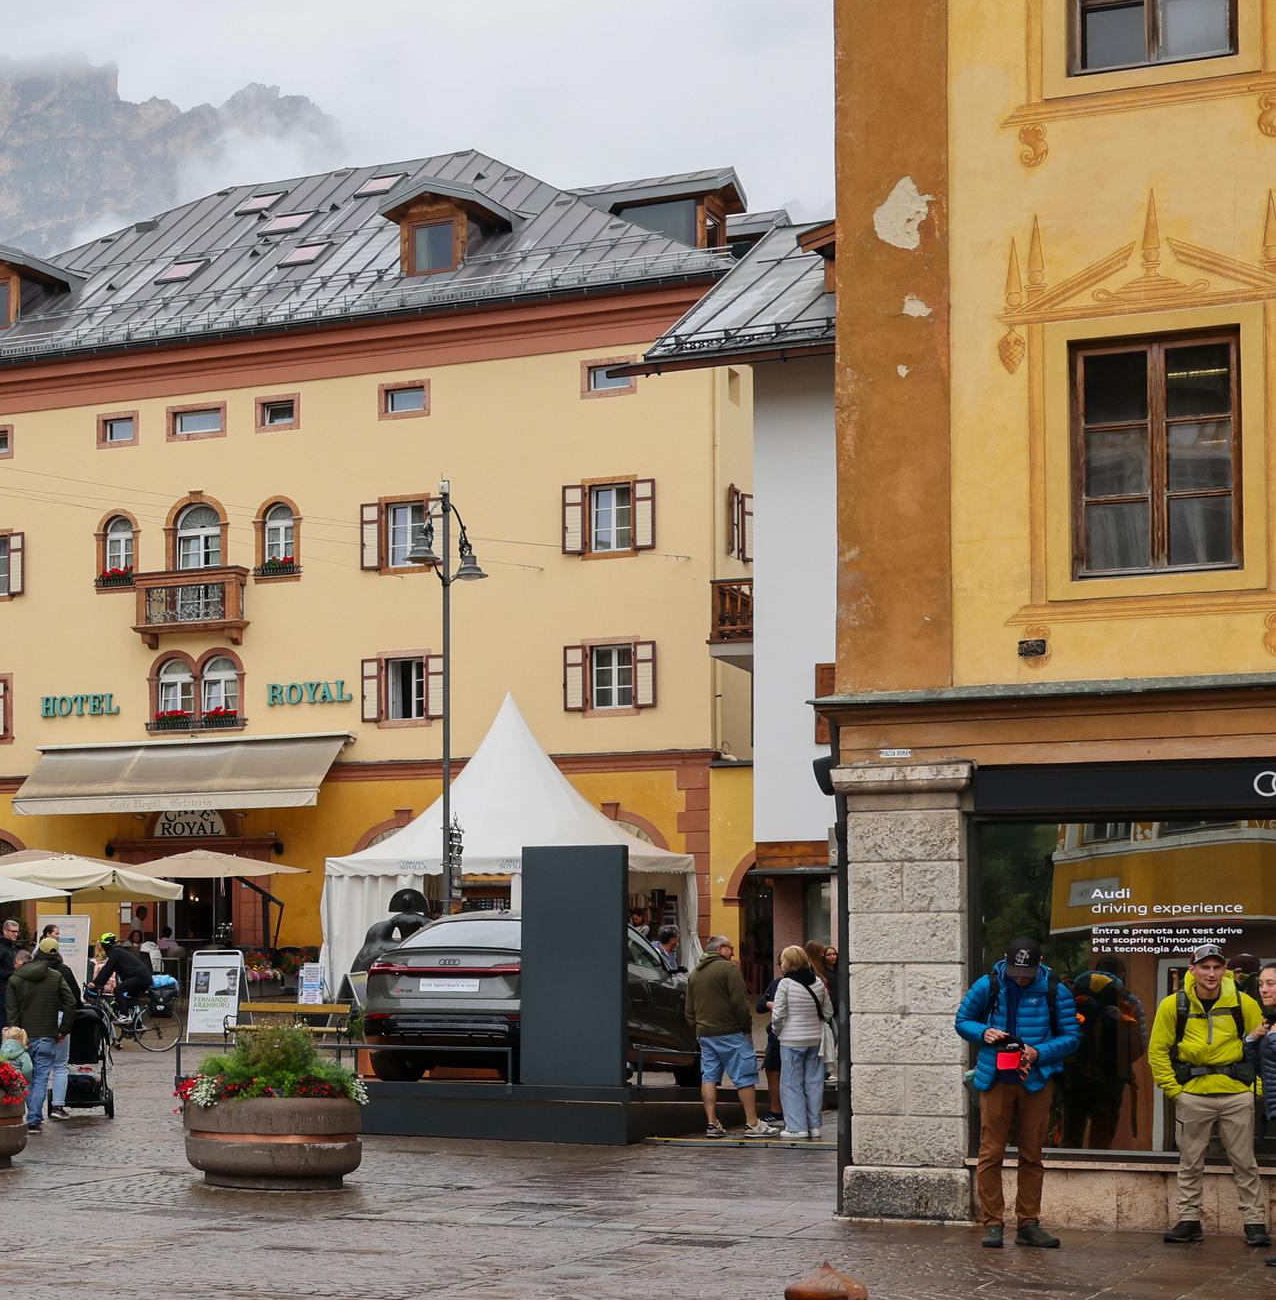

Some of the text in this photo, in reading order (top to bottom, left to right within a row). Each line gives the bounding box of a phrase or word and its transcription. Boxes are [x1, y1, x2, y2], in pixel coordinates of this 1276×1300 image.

[40, 679, 353, 717] HOTEL ROYAL
[160, 821, 221, 836] ROYAL
[1091, 888, 1131, 899] Audi
[1091, 902, 1244, 916] driving experience
[1092, 927, 1121, 935] Entra
[1132, 927, 1174, 936] prenota
[1192, 927, 1215, 935] test
[1216, 927, 1243, 935] drive
[1092, 936, 1227, 945] per scoprire l'innovazione
[1101, 945, 1112, 953] la
[1114, 945, 1170, 954] tecnologia
